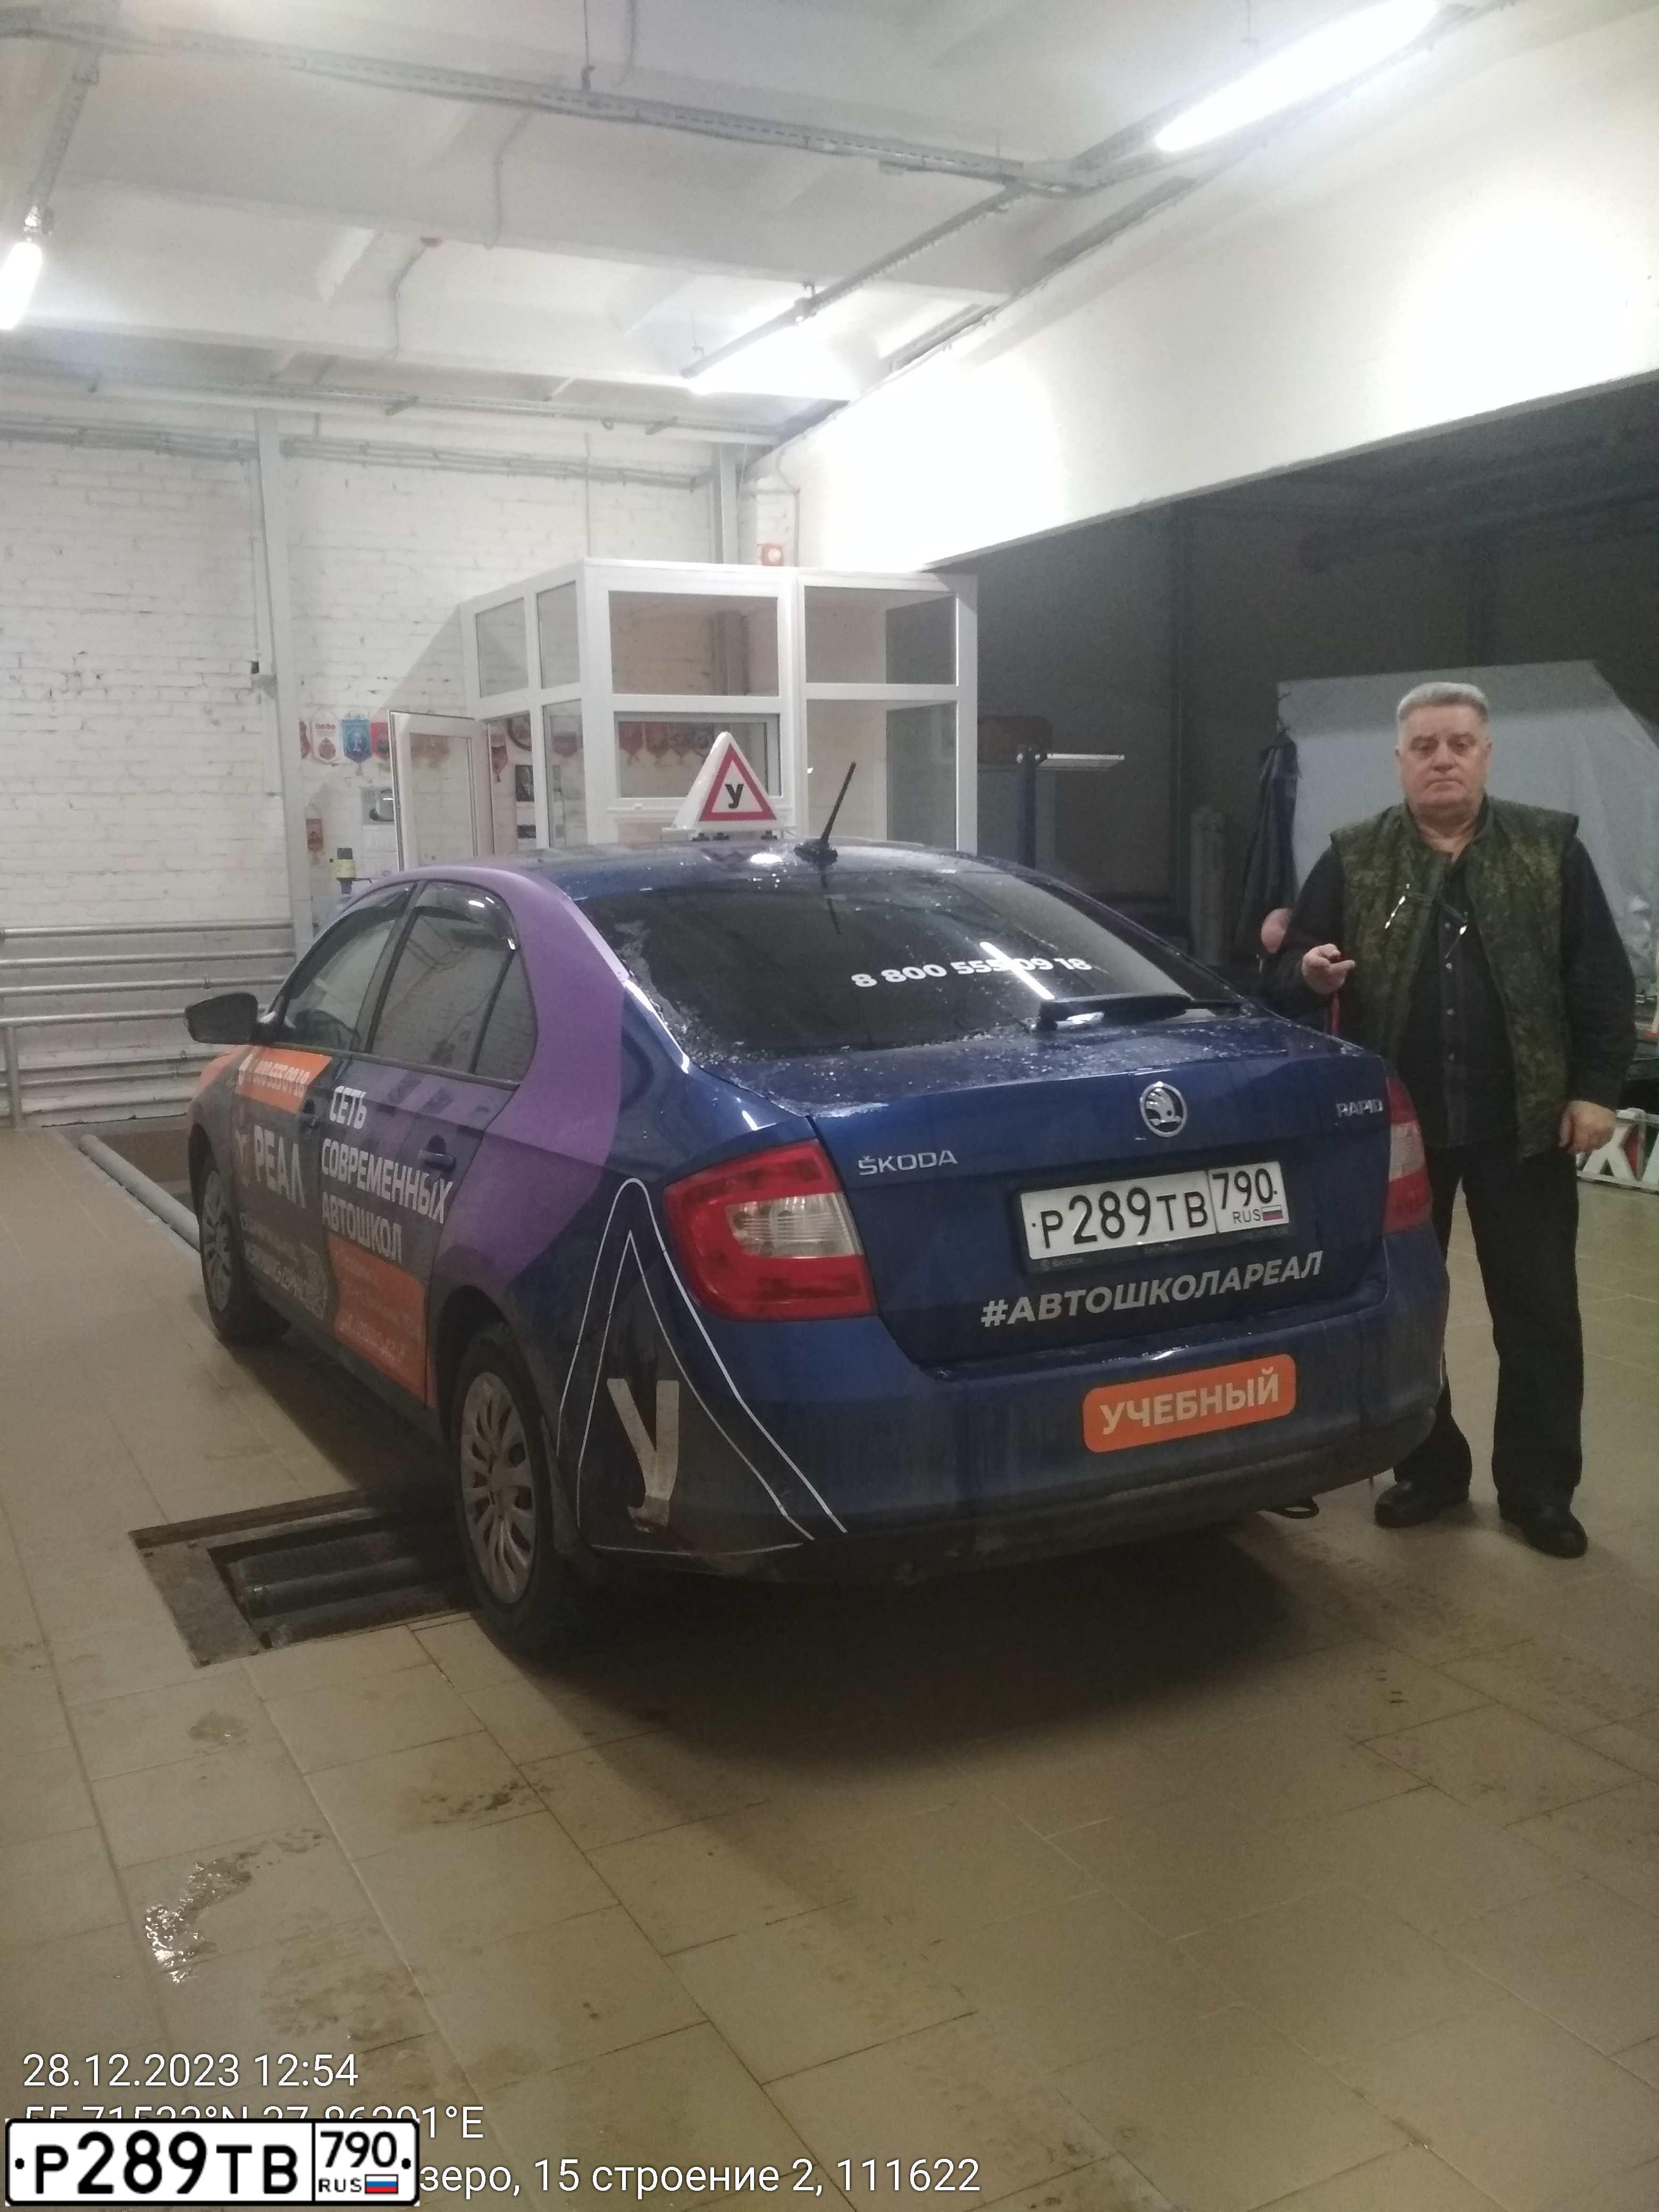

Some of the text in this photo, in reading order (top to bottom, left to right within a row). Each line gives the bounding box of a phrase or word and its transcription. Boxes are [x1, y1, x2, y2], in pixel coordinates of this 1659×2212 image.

[851, 974, 877, 987] 8
[881, 964, 947, 983] 800
[1054, 958, 1092, 970] 18
[329, 1086, 367, 1129] СЕТЬ
[1336, 1099, 1382, 1117] RAPID
[254, 1125, 306, 1209] РЕАЛ
[322, 1138, 453, 1224] СОВРЕМЕННЫХ
[858, 1150, 958, 1175] ŠKODA
[1213, 1168, 1273, 1210] 790
[322, 1192, 403, 1263] АВТОШКОЛ
[1233, 1209, 1261, 1223] RUS
[981, 1251, 1323, 1328] #АВТОШКОЛАРЕАЛ
[1100, 1367, 1279, 1435] УЧЕБНЫЙ
